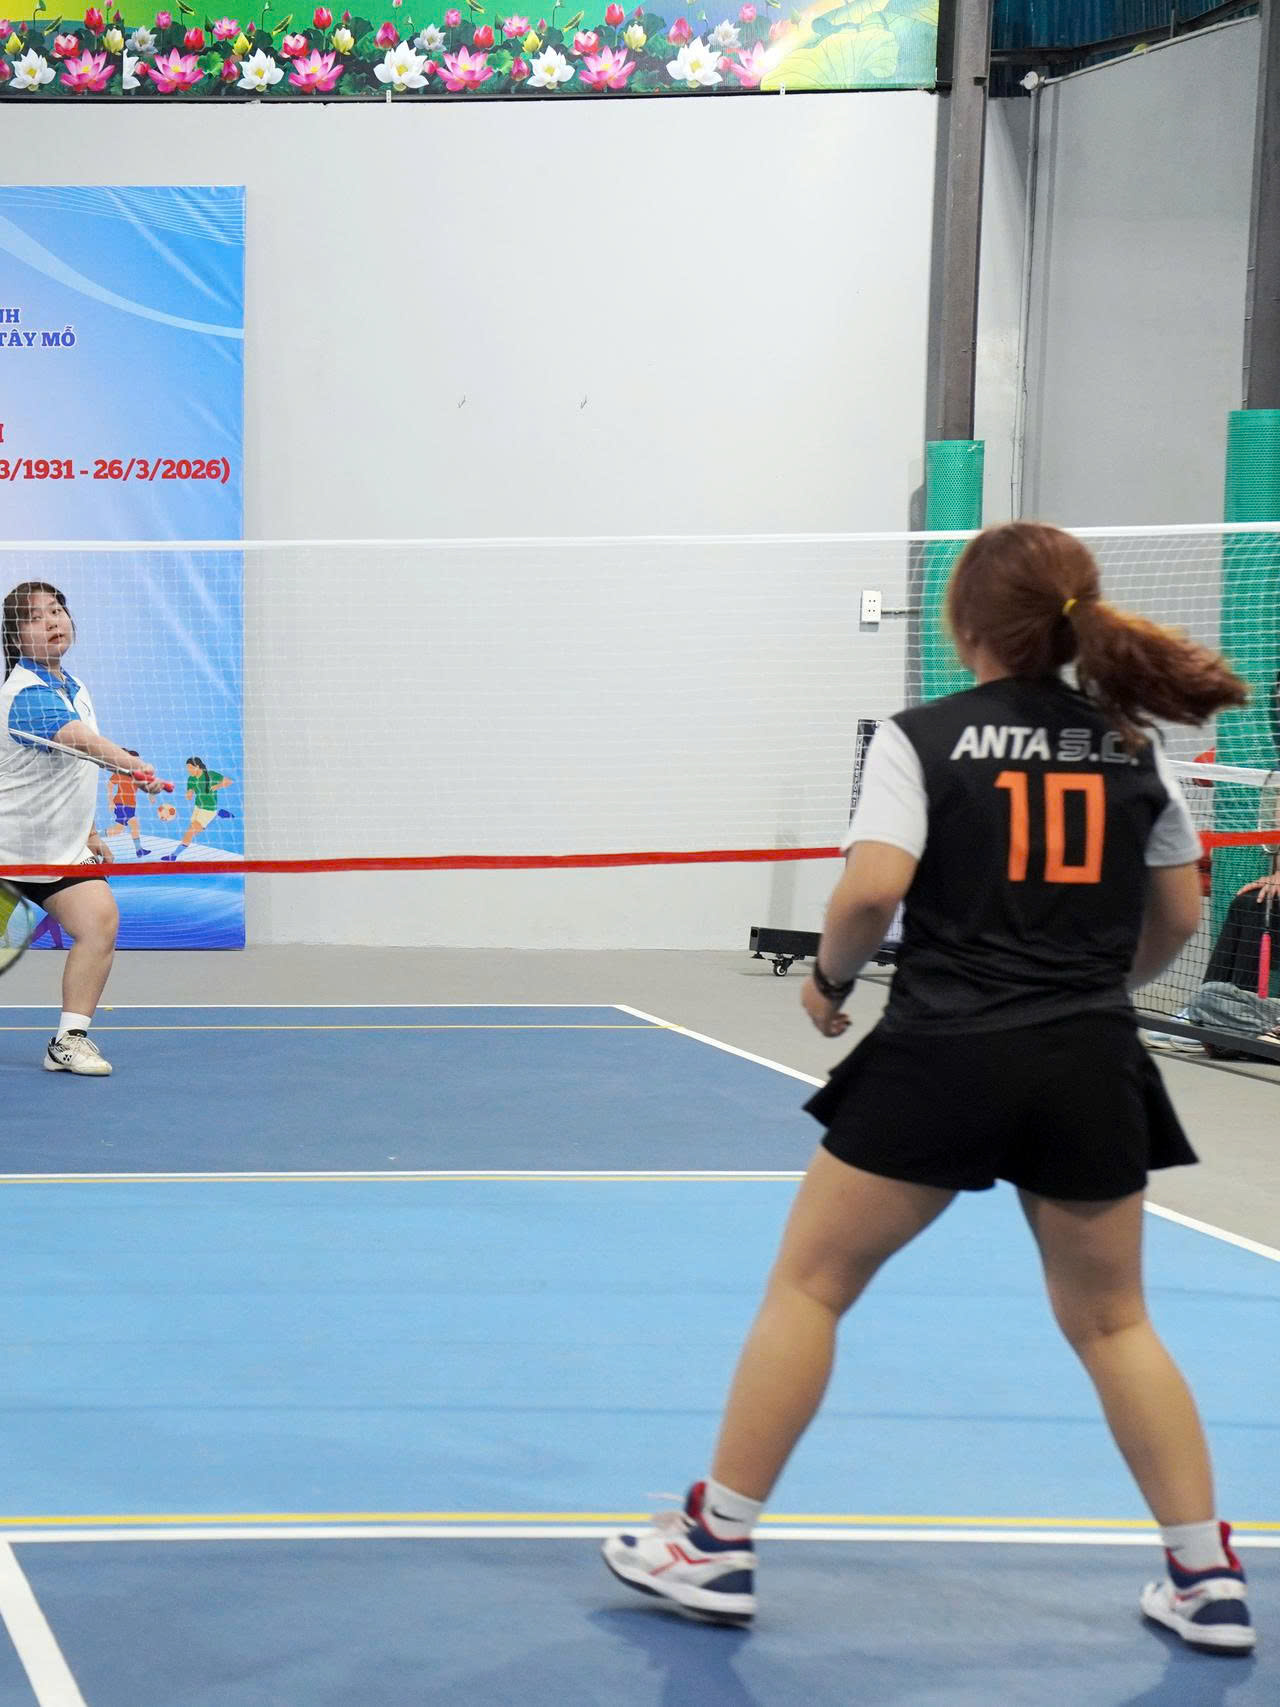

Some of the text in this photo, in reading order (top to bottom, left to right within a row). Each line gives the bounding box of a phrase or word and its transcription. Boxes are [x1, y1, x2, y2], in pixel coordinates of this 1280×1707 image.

[41, 326, 76, 347] MỖ
[93, 457, 230, 485] 26/3/2026)
[950, 725, 1051, 761] ANTA
[993, 770, 1106, 884] 10
